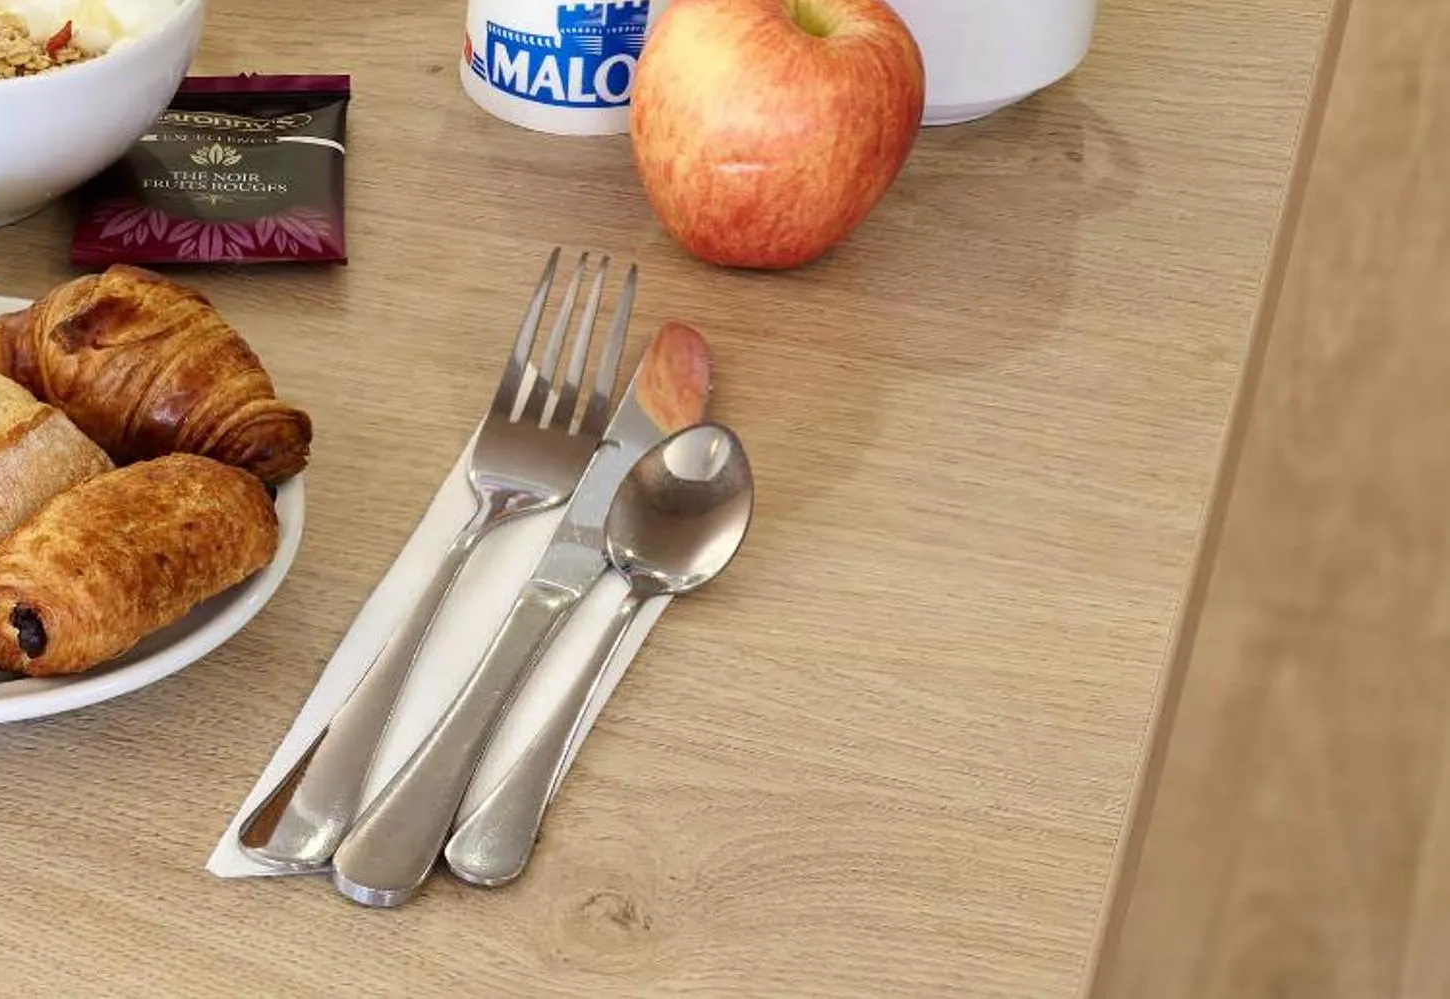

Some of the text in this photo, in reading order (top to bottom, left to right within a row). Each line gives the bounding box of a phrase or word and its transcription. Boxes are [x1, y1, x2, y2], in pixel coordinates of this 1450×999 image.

[492, 41, 638, 103] MALO
[212, 172, 260, 182] NOIR
[143, 179, 288, 193] FRUITS ROUGES
